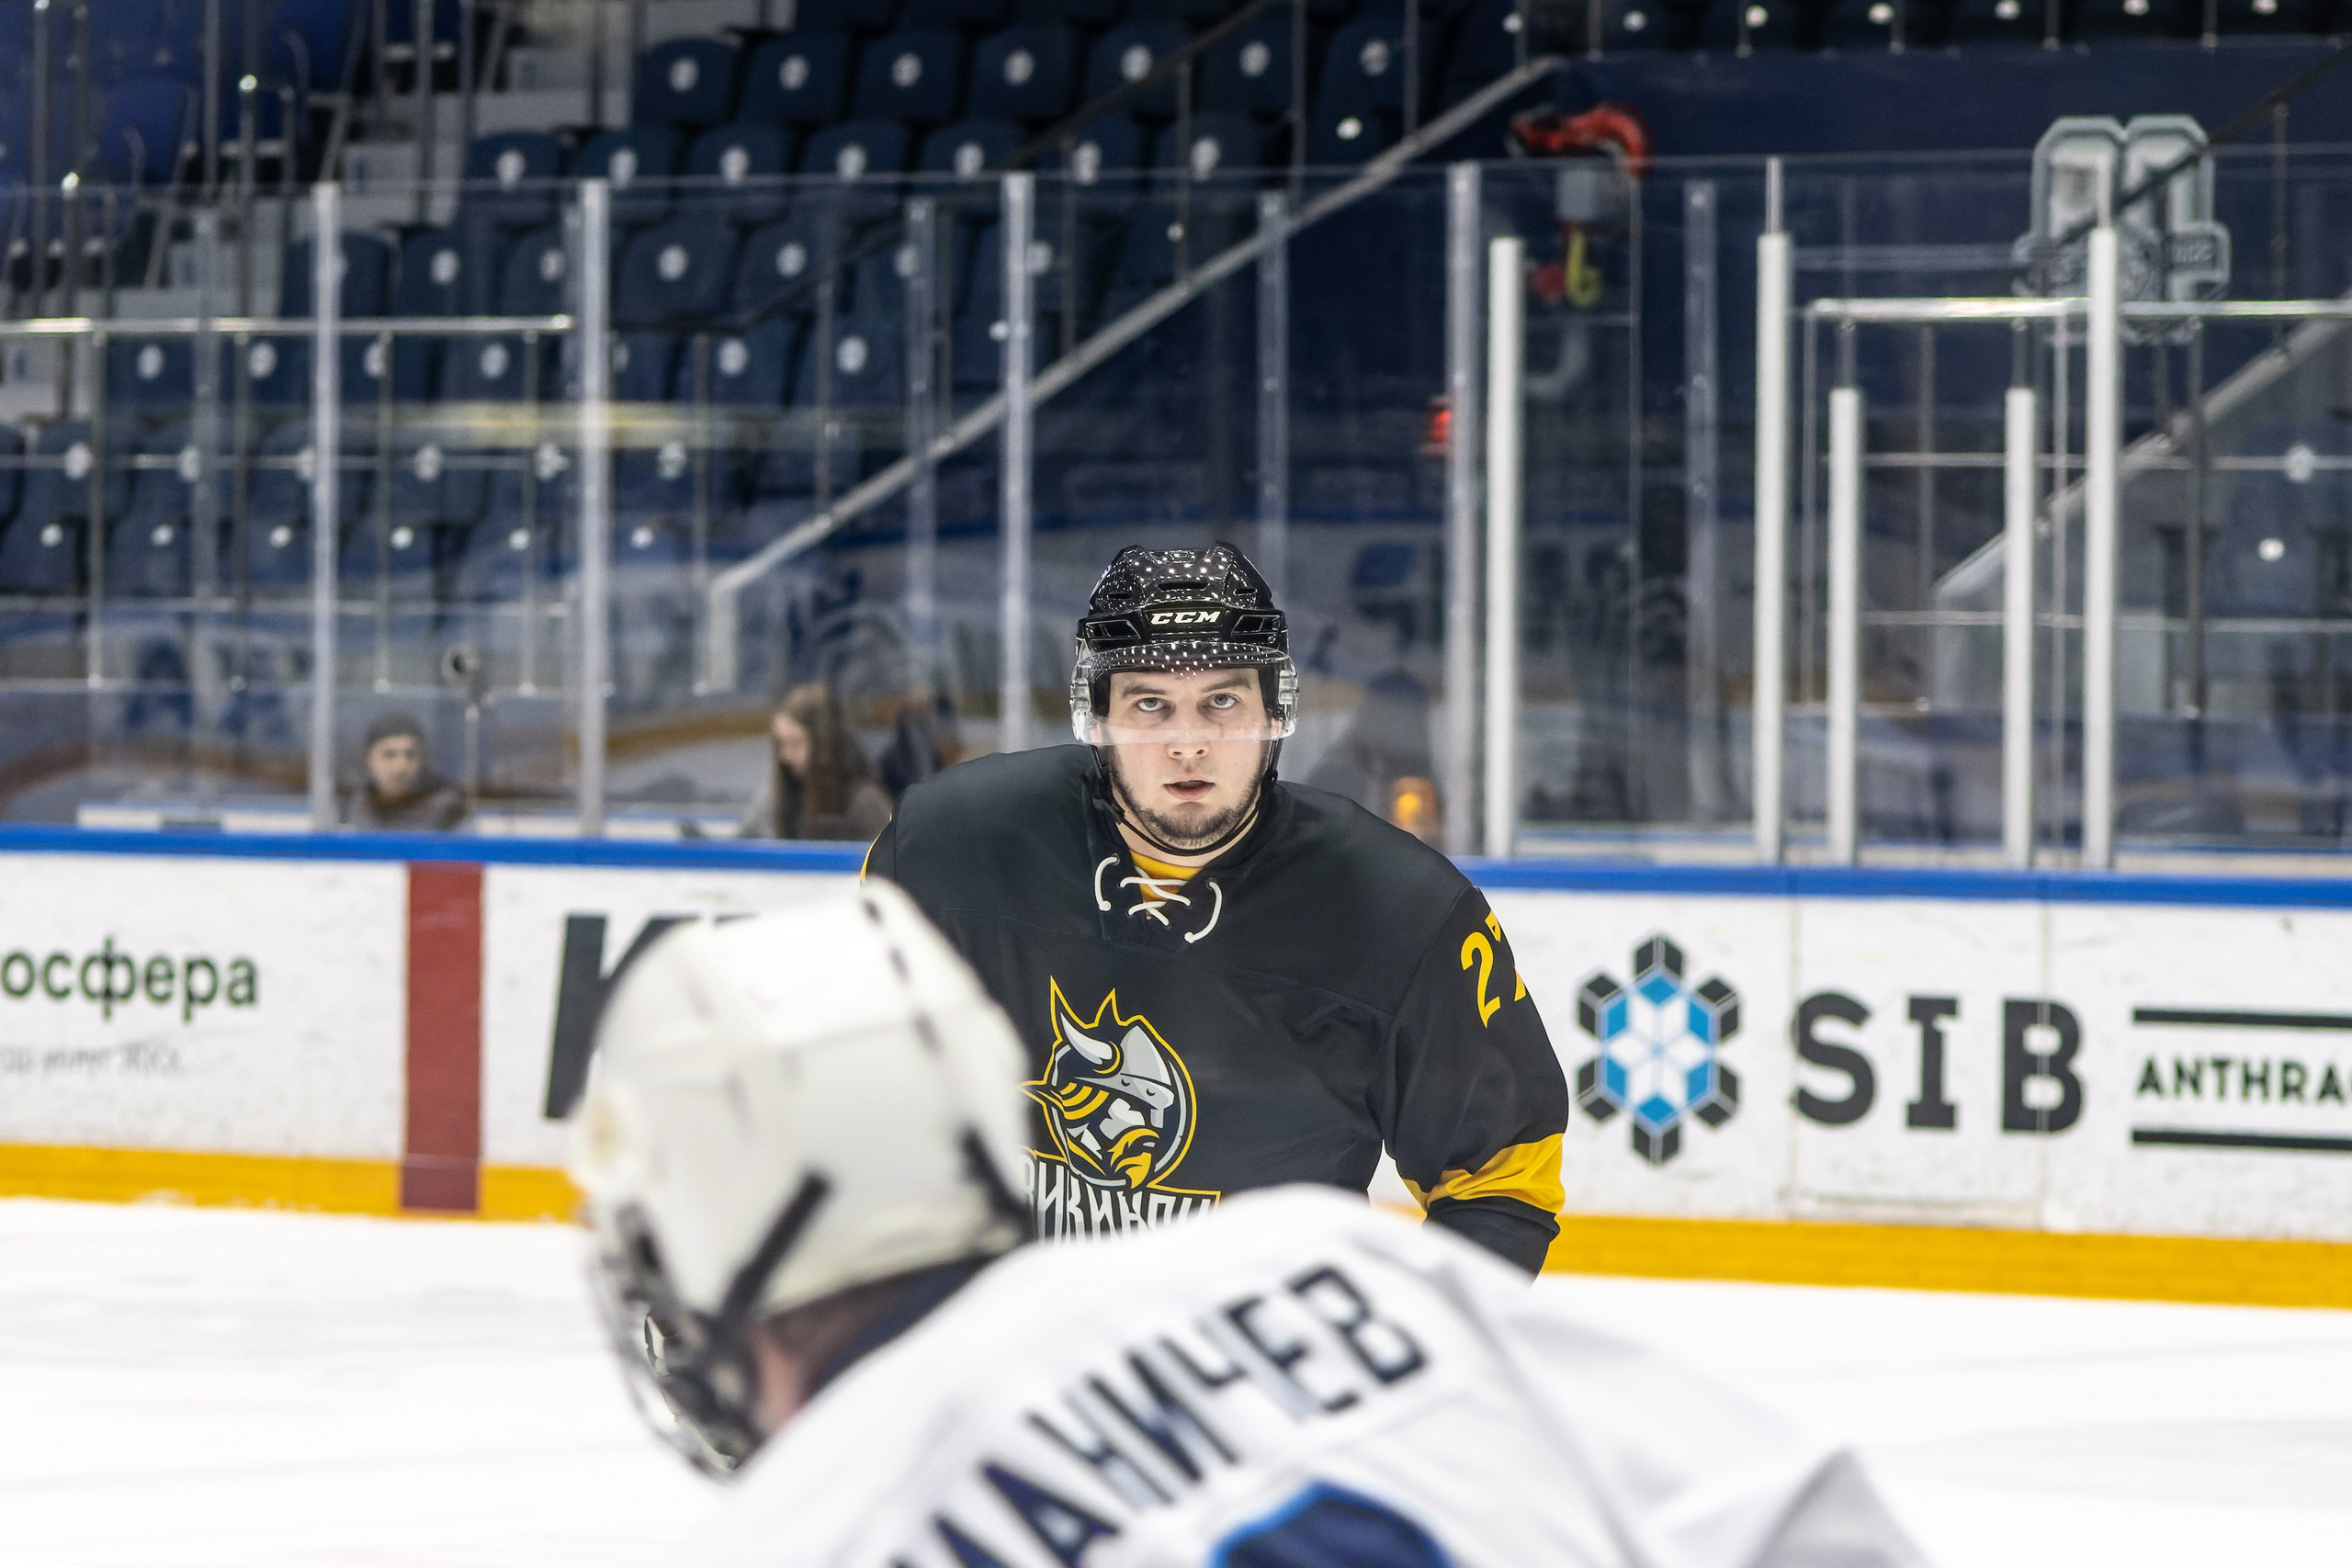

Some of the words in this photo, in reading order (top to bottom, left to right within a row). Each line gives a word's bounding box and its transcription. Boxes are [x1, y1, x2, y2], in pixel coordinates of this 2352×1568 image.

[1150, 611, 1221, 626] CCM
[0, 936, 259, 1023] осфера
[1790, 990, 2085, 1135] SIB
[2134, 1055, 2352, 1105] ANTHRA
[1016, 1154, 1214, 1242] ВИКИН
[887, 1262, 1429, 1568] АНИЧЕВ
